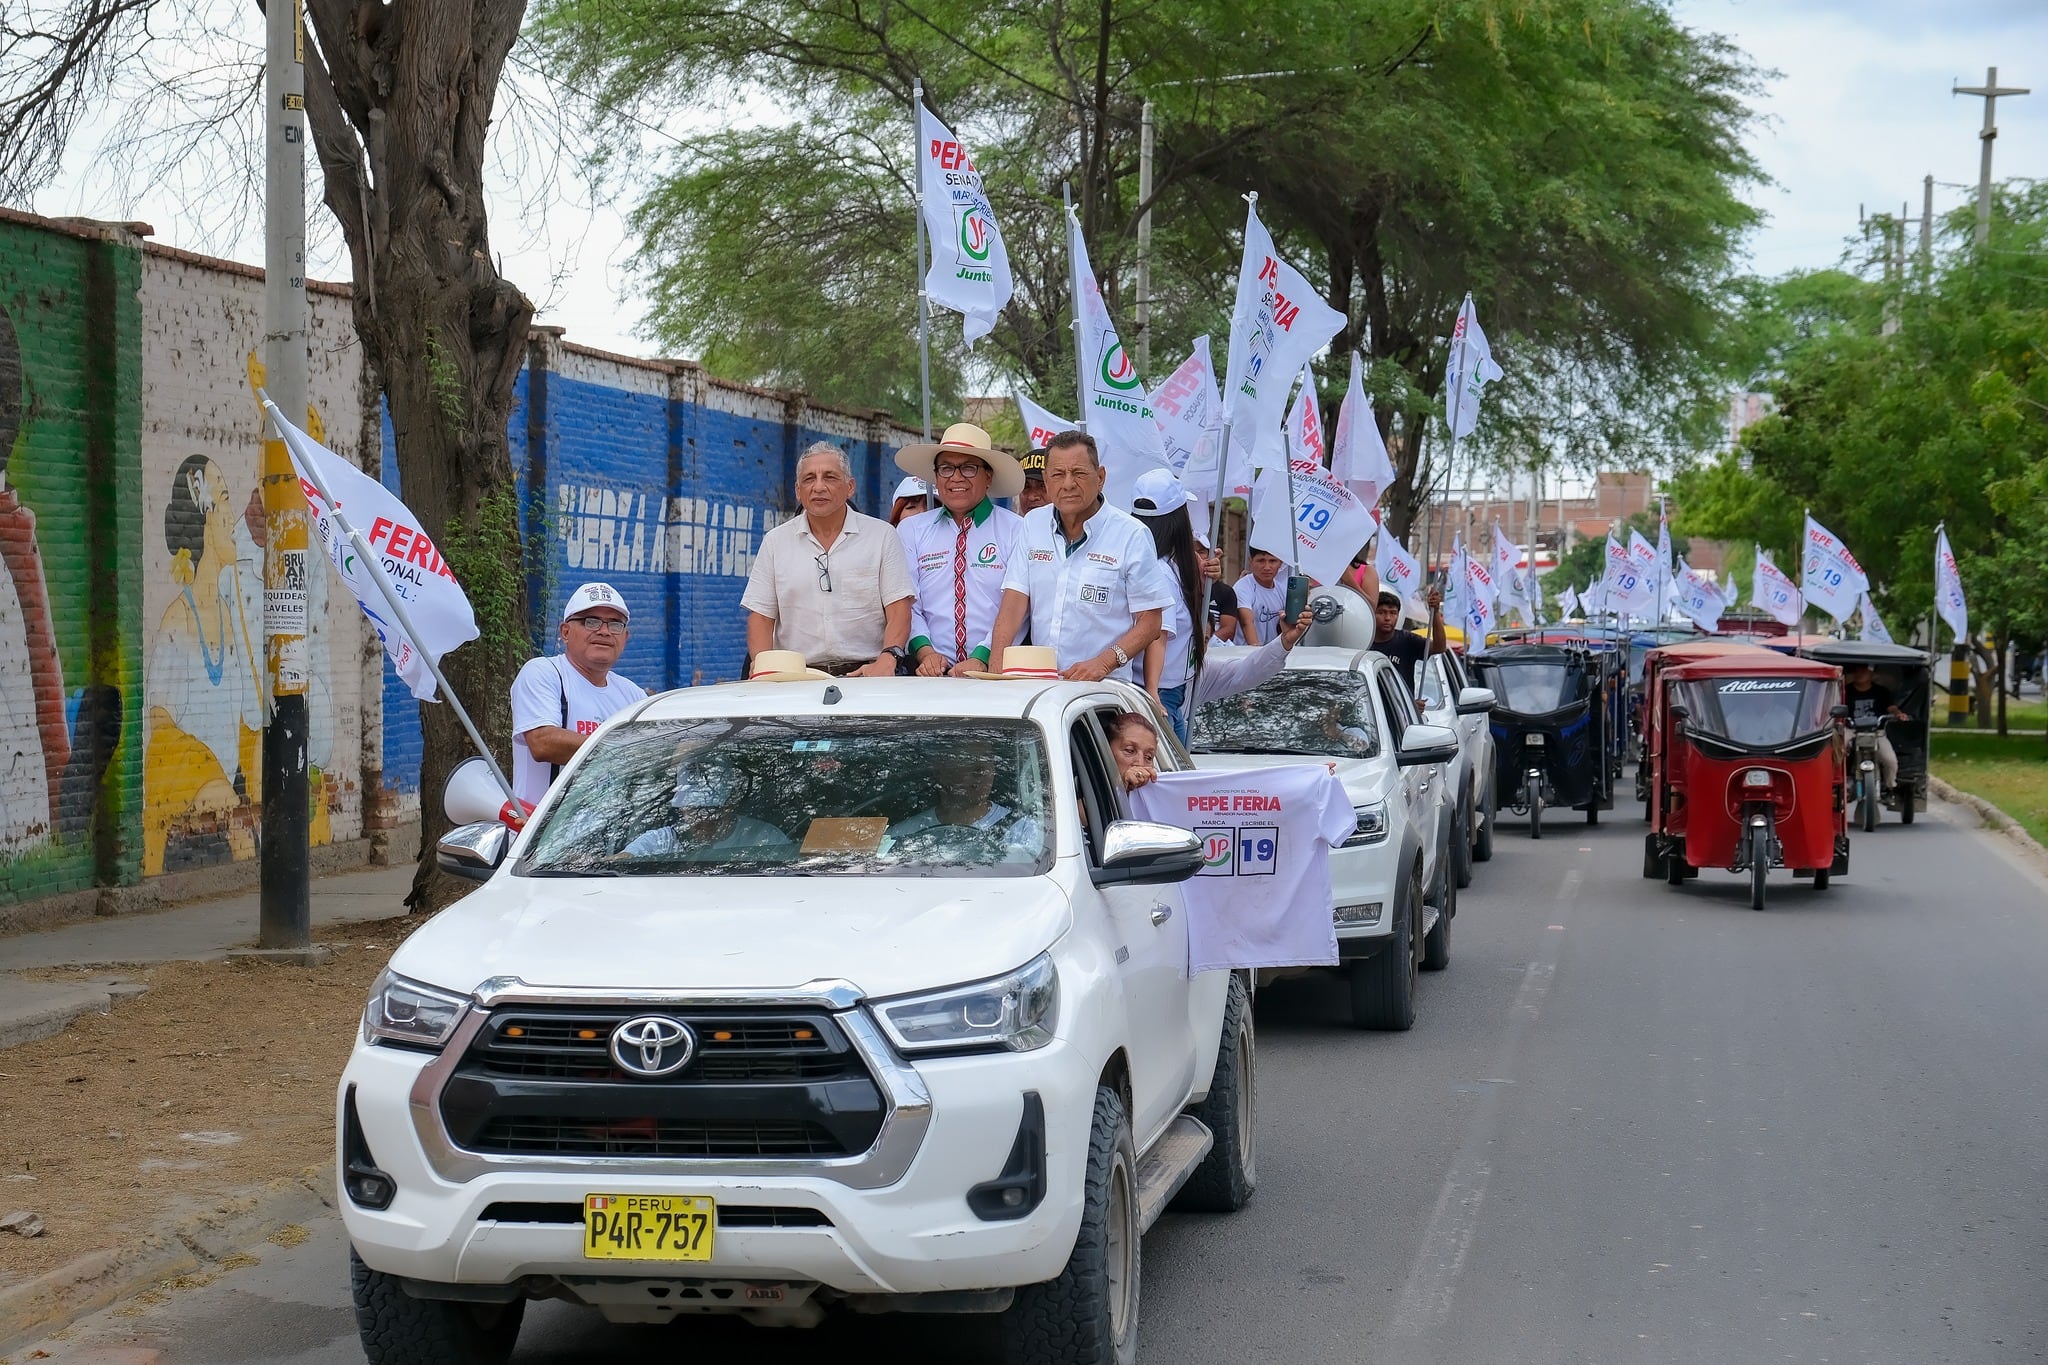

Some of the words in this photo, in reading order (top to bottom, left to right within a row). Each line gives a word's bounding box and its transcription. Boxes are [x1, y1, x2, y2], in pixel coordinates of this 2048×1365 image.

[1095, 394, 1138, 414] Juntos
[1316, 478, 1352, 501] NACIONAL
[1297, 503, 1330, 531] 19
[1297, 534, 1317, 550] Perú
[1616, 573, 1636, 590] 19
[1823, 568, 1842, 587] 19
[1097, 592, 1106, 601] 19
[1691, 597, 1704, 609] 19
[1772, 591, 1788, 604] 19
[1187, 796, 1229, 811] PEPE
[1233, 796, 1281, 811] FERIA
[1241, 838, 1274, 862] 19
[628, 1199, 672, 1211] PERU
[591, 1211, 708, 1250] P4R-757
[750, 1289, 780, 1299] ARB
